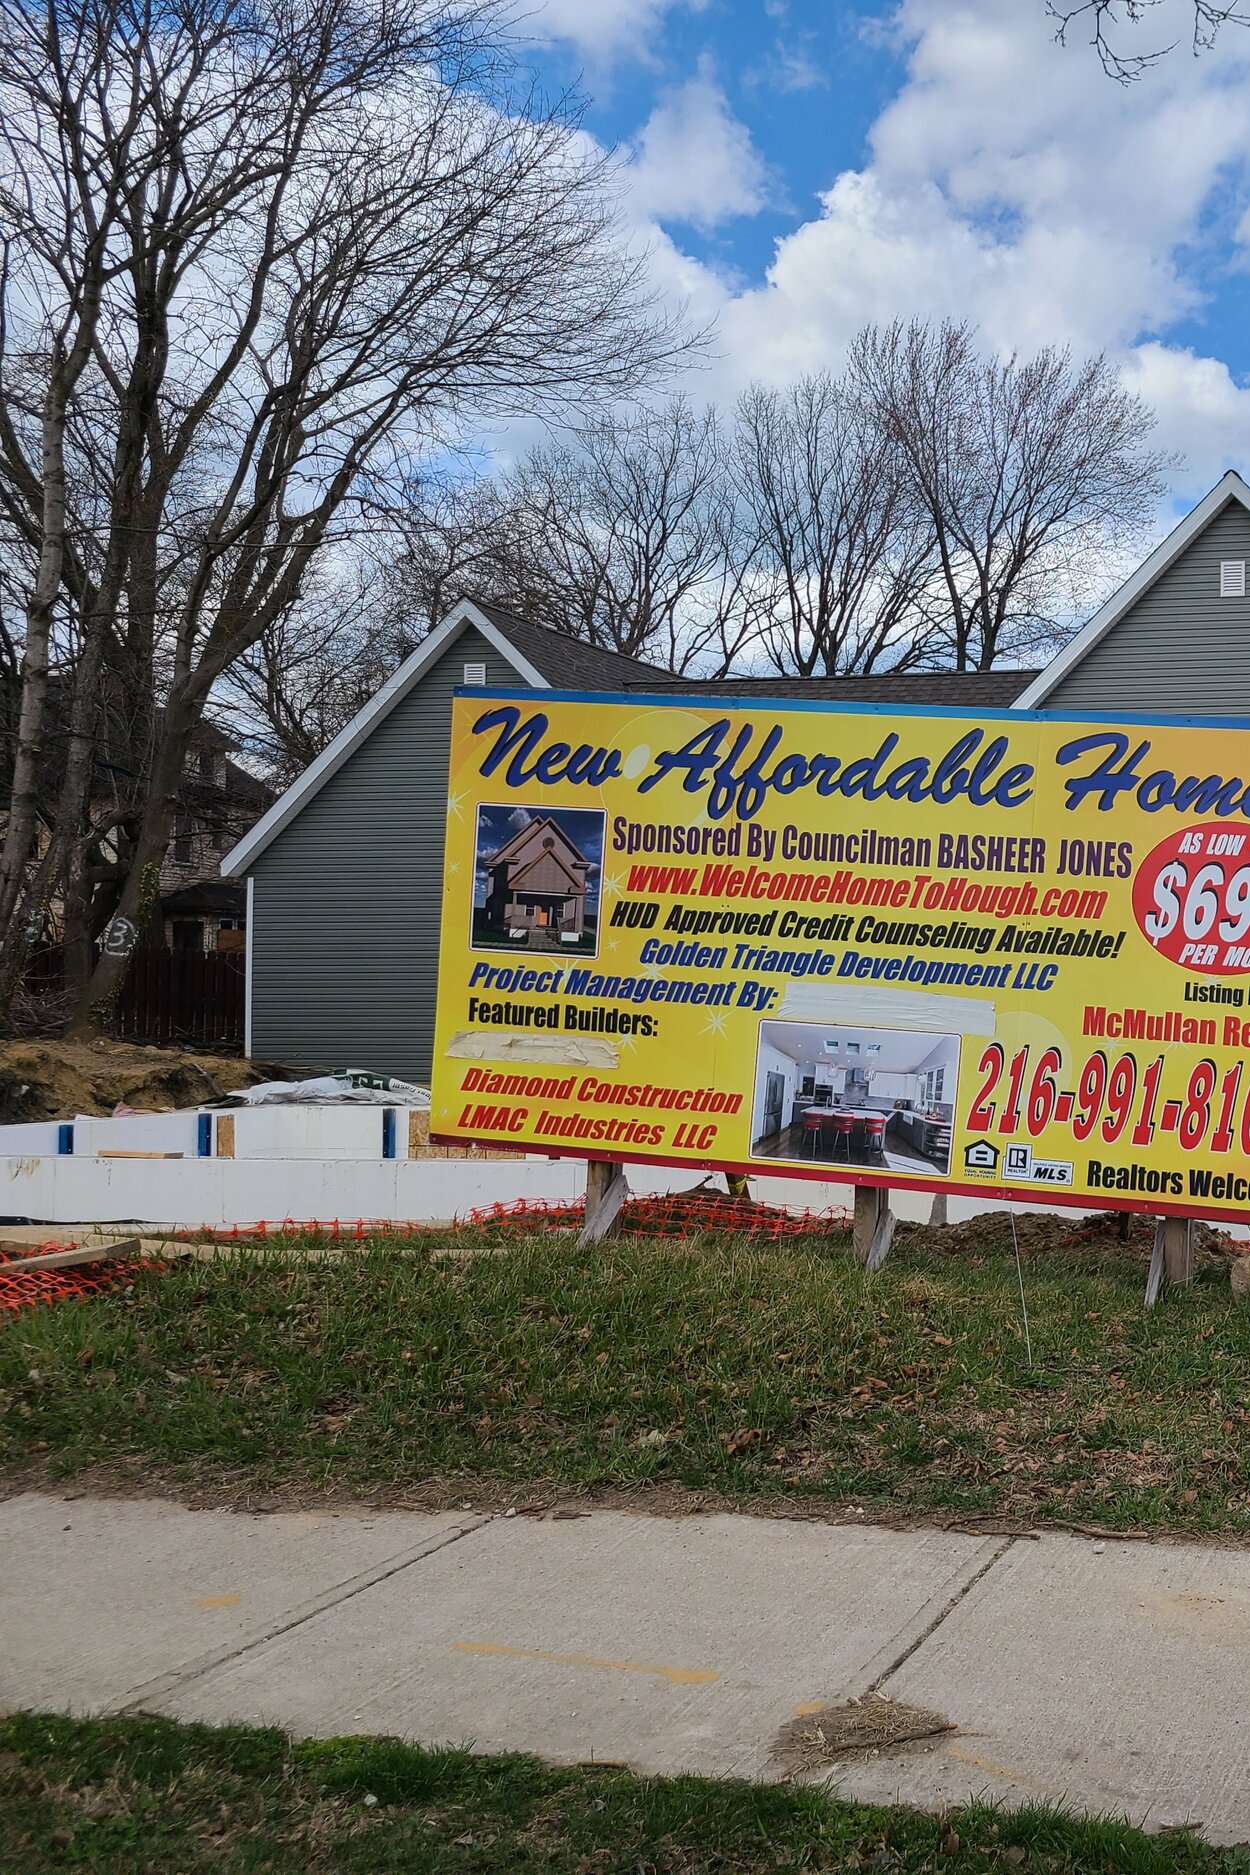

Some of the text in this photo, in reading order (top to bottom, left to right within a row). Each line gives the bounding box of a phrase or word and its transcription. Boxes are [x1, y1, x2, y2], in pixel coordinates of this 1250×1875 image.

[472, 706, 622, 788] New
[637, 718, 1034, 821] Affordable
[612, 816, 1132, 878] Sponsored By Councilman BASHEER JONES
[1178, 832, 1203, 854] AS
[1206, 833, 1246, 856] LOW
[627, 863, 1109, 919] www.WelcomeHomeToHough.com
[609, 901, 1127, 959] HUD Approved Credit Counseling Available!
[639, 938, 1059, 991] Golden Triangle Development LLC
[1178, 943, 1219, 966] PER
[468, 962, 779, 1011] Project Management By:
[1184, 982, 1244, 1007] Listing
[468, 997, 659, 1037] Featured Builders:
[1082, 1005, 1217, 1045] McMullan
[460, 1067, 578, 1100] Diamond
[577, 1076, 744, 1114] Construction
[457, 1103, 718, 1150] LMAC Industries LLC
[1034, 1167, 1068, 1181] MLS
[1087, 1160, 1183, 1196] Realtors
